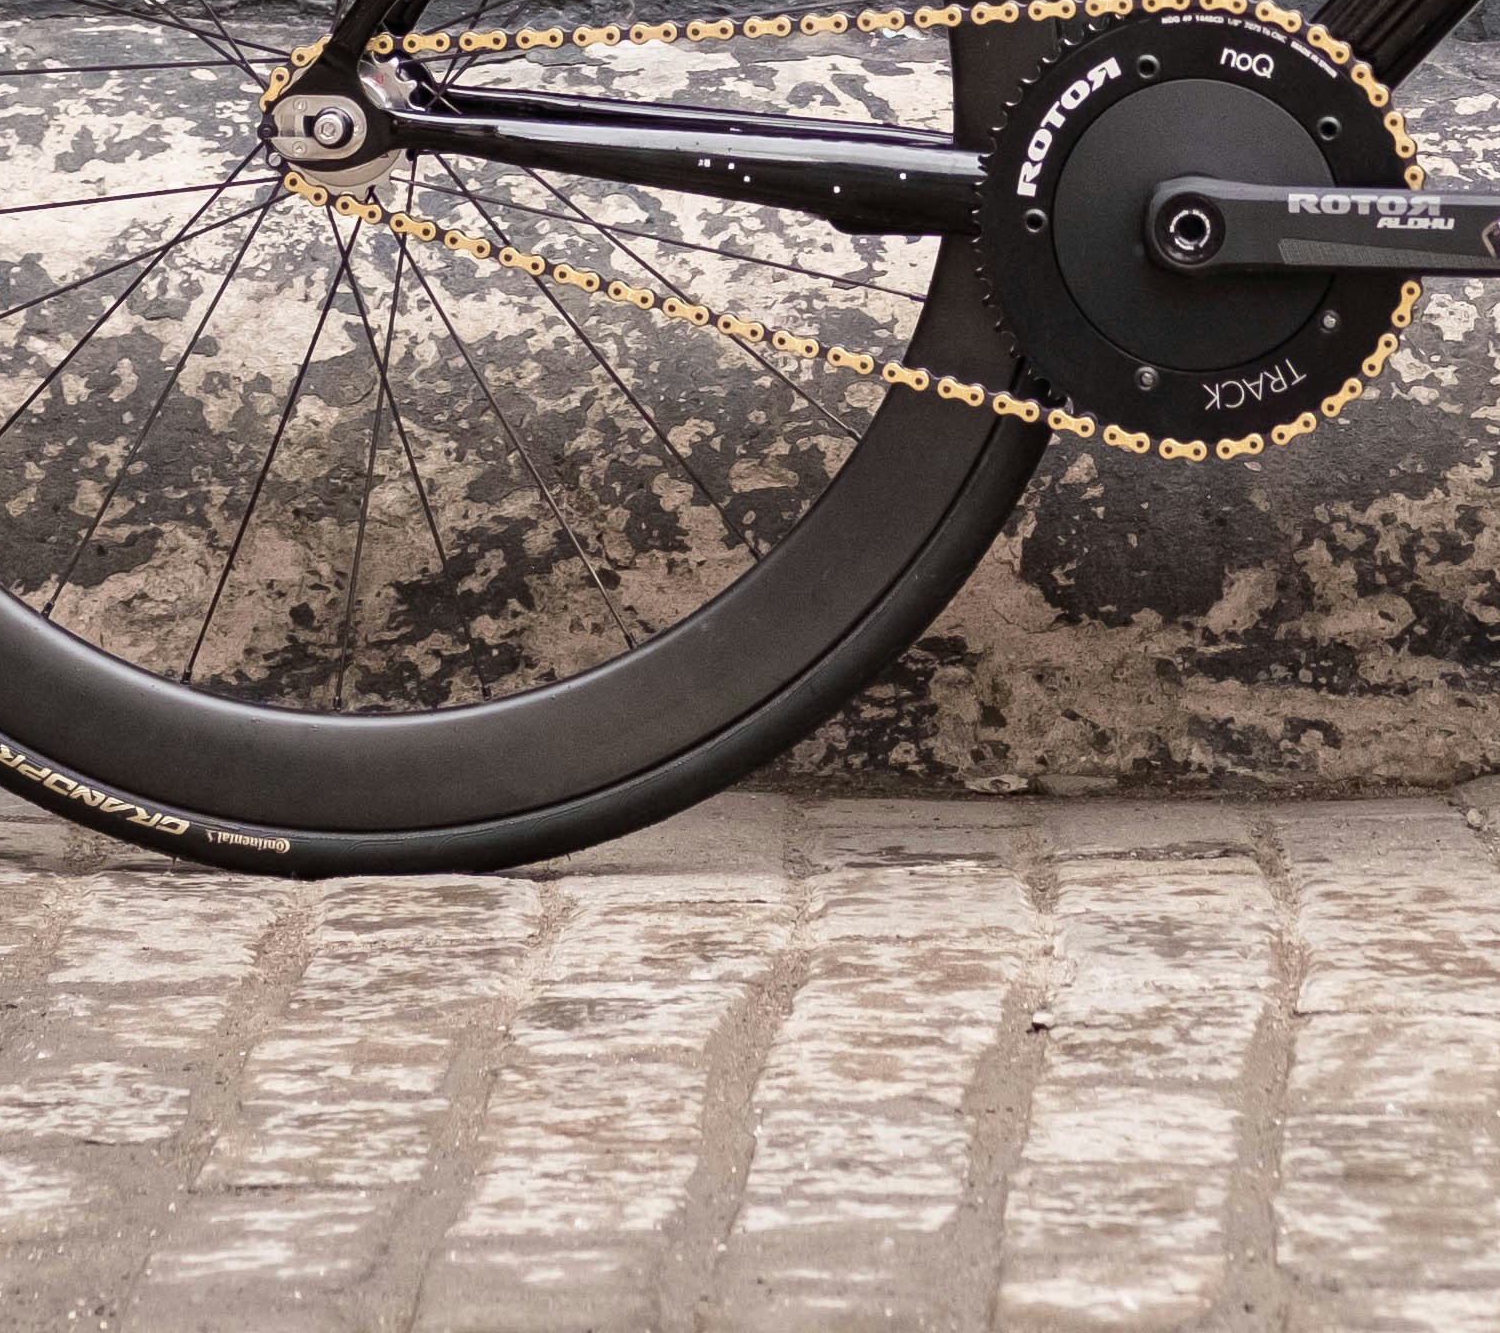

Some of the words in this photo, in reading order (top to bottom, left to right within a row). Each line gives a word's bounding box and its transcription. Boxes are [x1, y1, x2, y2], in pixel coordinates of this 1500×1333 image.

[1220, 45, 1275, 79] noQ
[1376, 217, 1456, 230] ALDHU
[1203, 358, 1307, 411] TRACK
[216, 831, 292, 854] Continental
